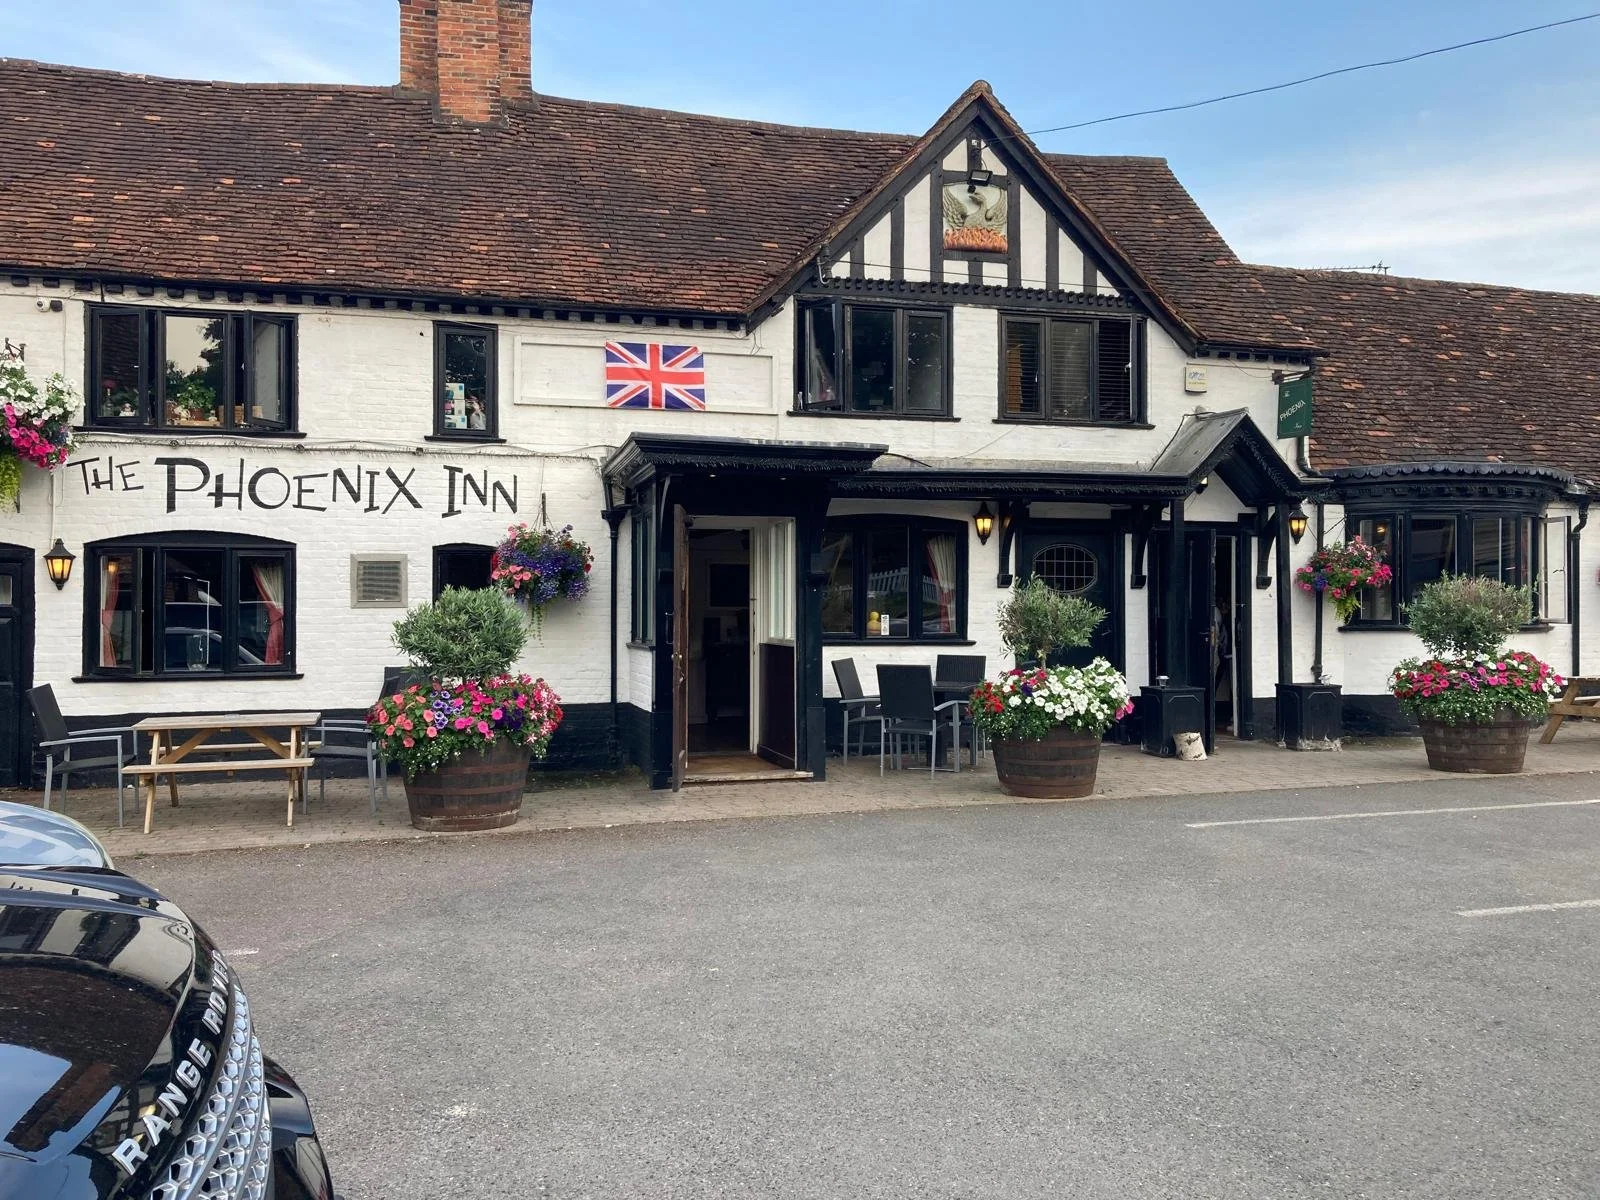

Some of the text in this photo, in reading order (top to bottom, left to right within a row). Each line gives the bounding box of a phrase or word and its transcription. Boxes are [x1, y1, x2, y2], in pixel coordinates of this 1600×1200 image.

[68, 455, 519, 519] THE PHOENIX INN
[112, 1037, 213, 1176] RANGE
